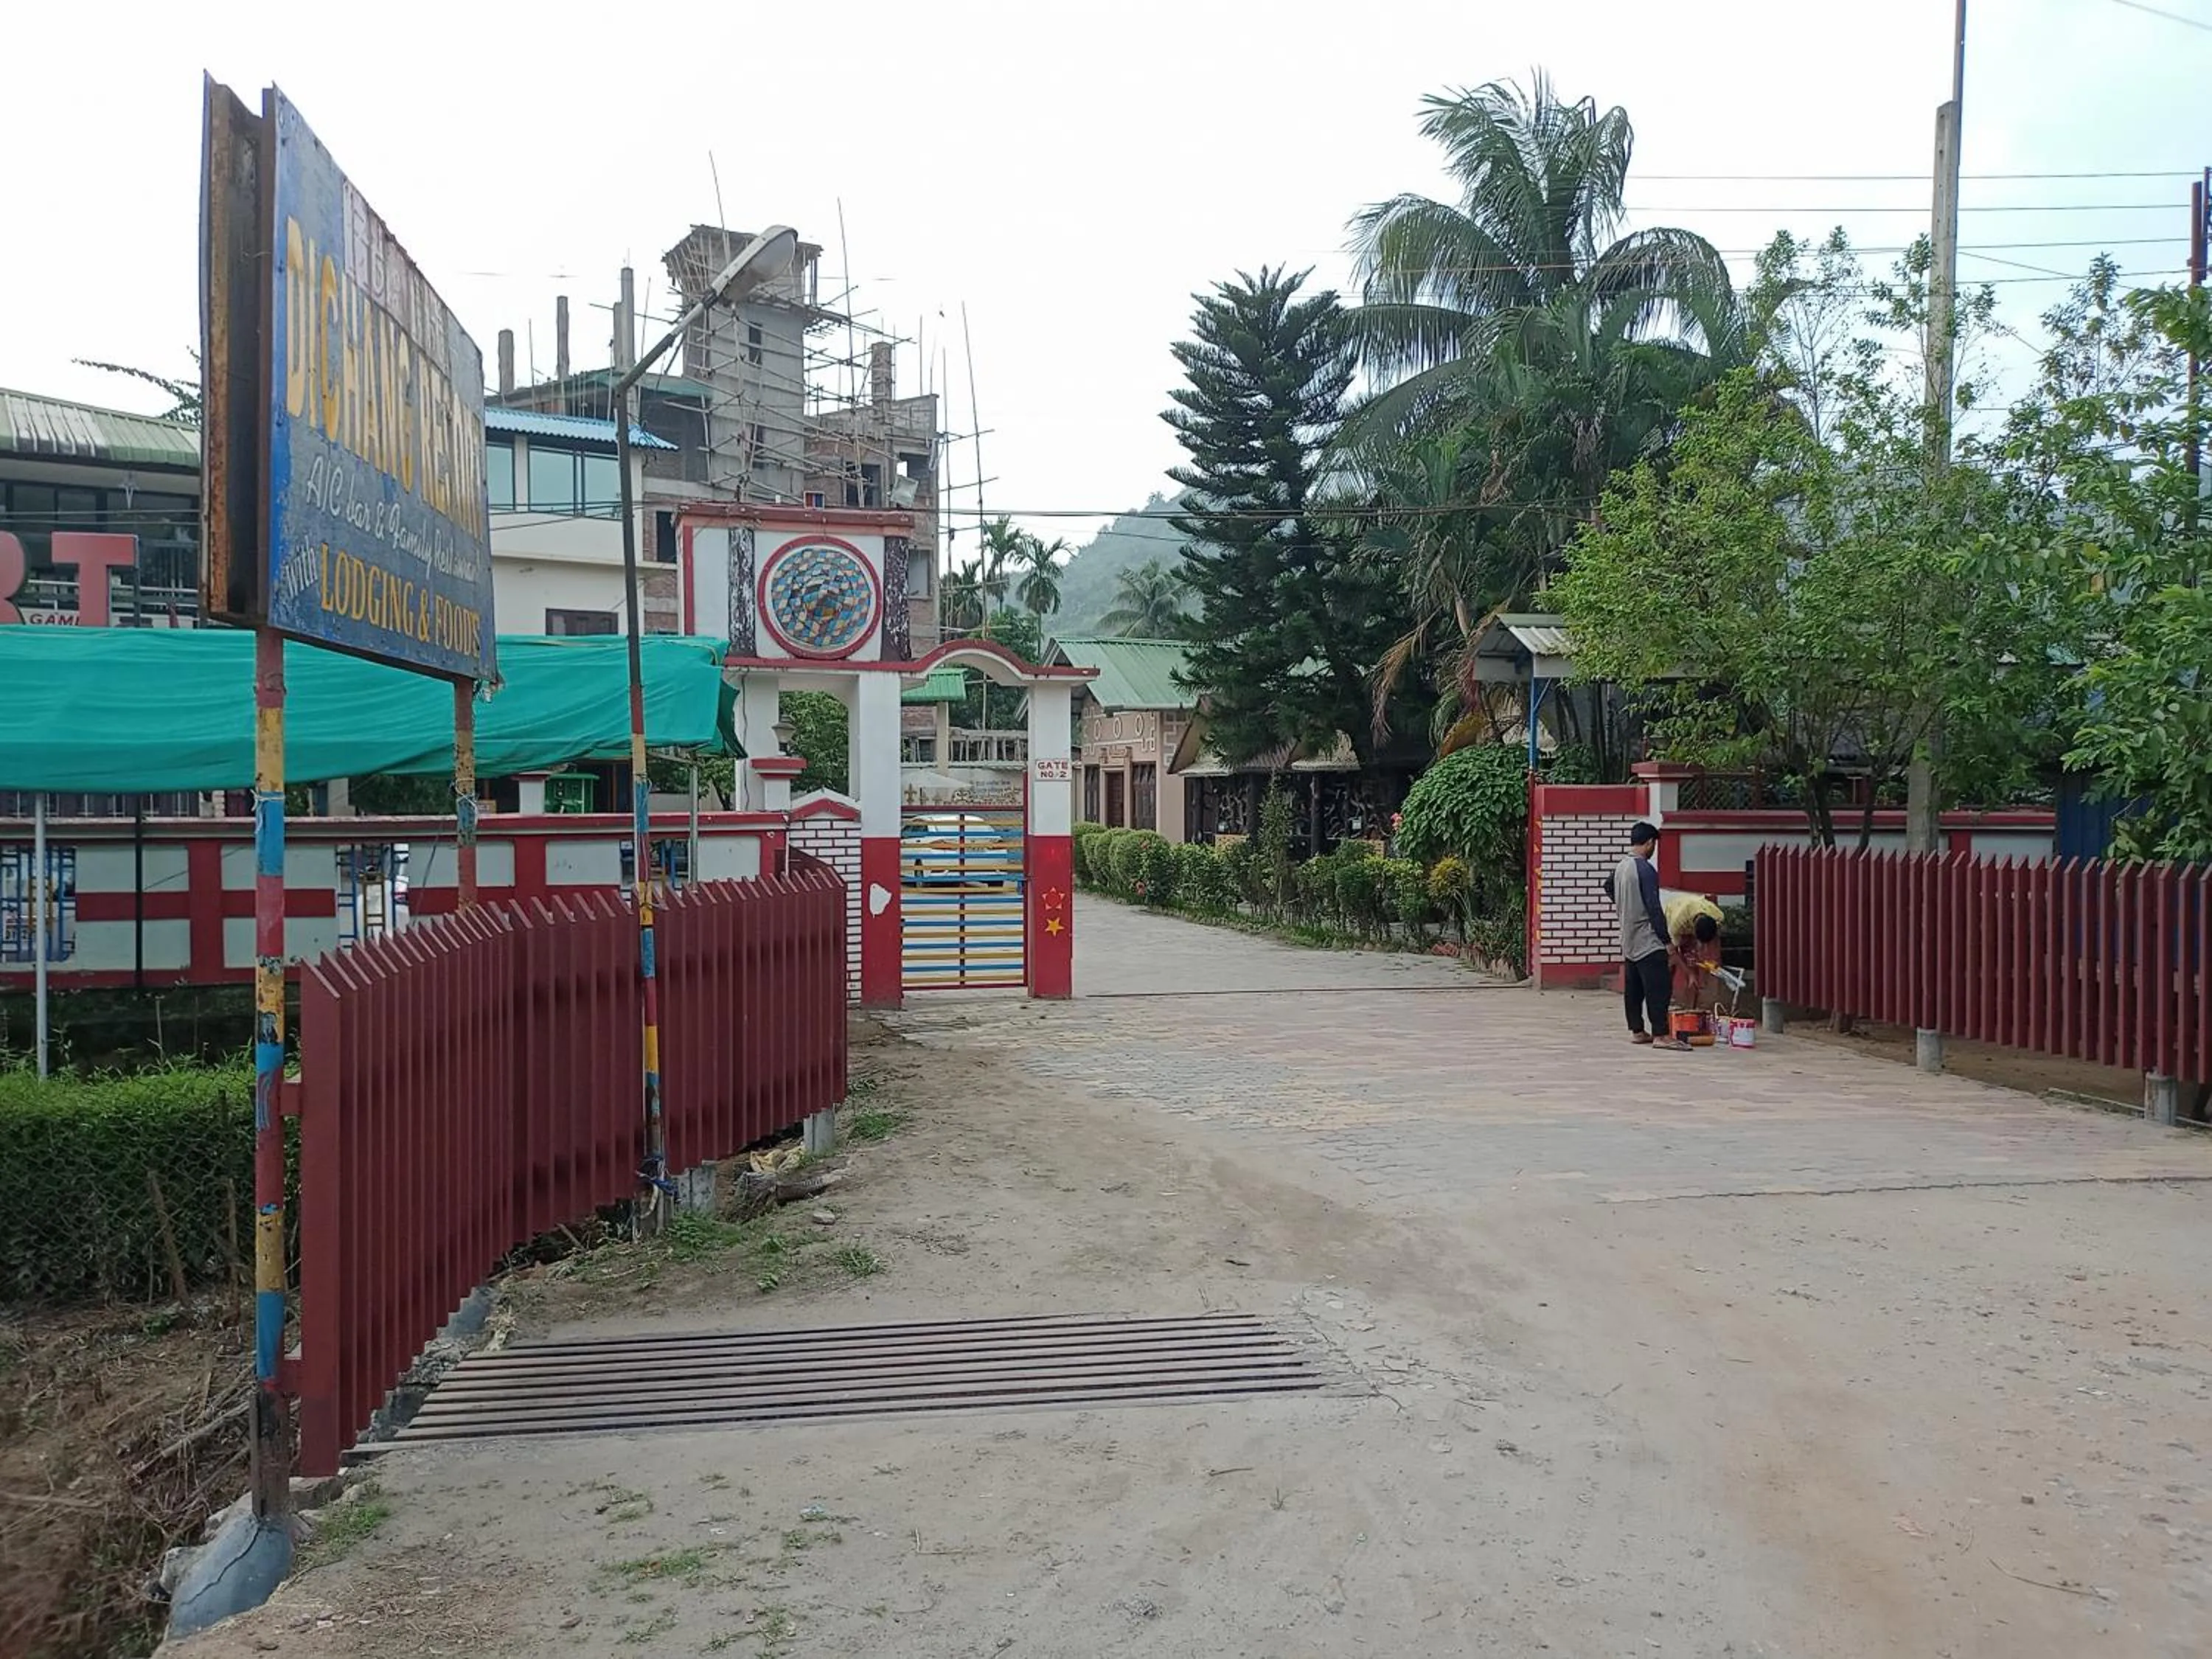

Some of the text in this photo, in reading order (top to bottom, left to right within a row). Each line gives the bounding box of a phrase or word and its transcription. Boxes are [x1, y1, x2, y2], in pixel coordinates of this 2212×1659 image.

[287, 215, 412, 494] DICHANG
[307, 456, 344, 516] A/C
[347, 474, 370, 531] bar
[375, 501, 384, 540] &
[389, 503, 432, 580] Family
[283, 535, 481, 660] with LODGING & FOODS
[1037, 761, 1068, 770] GATE
